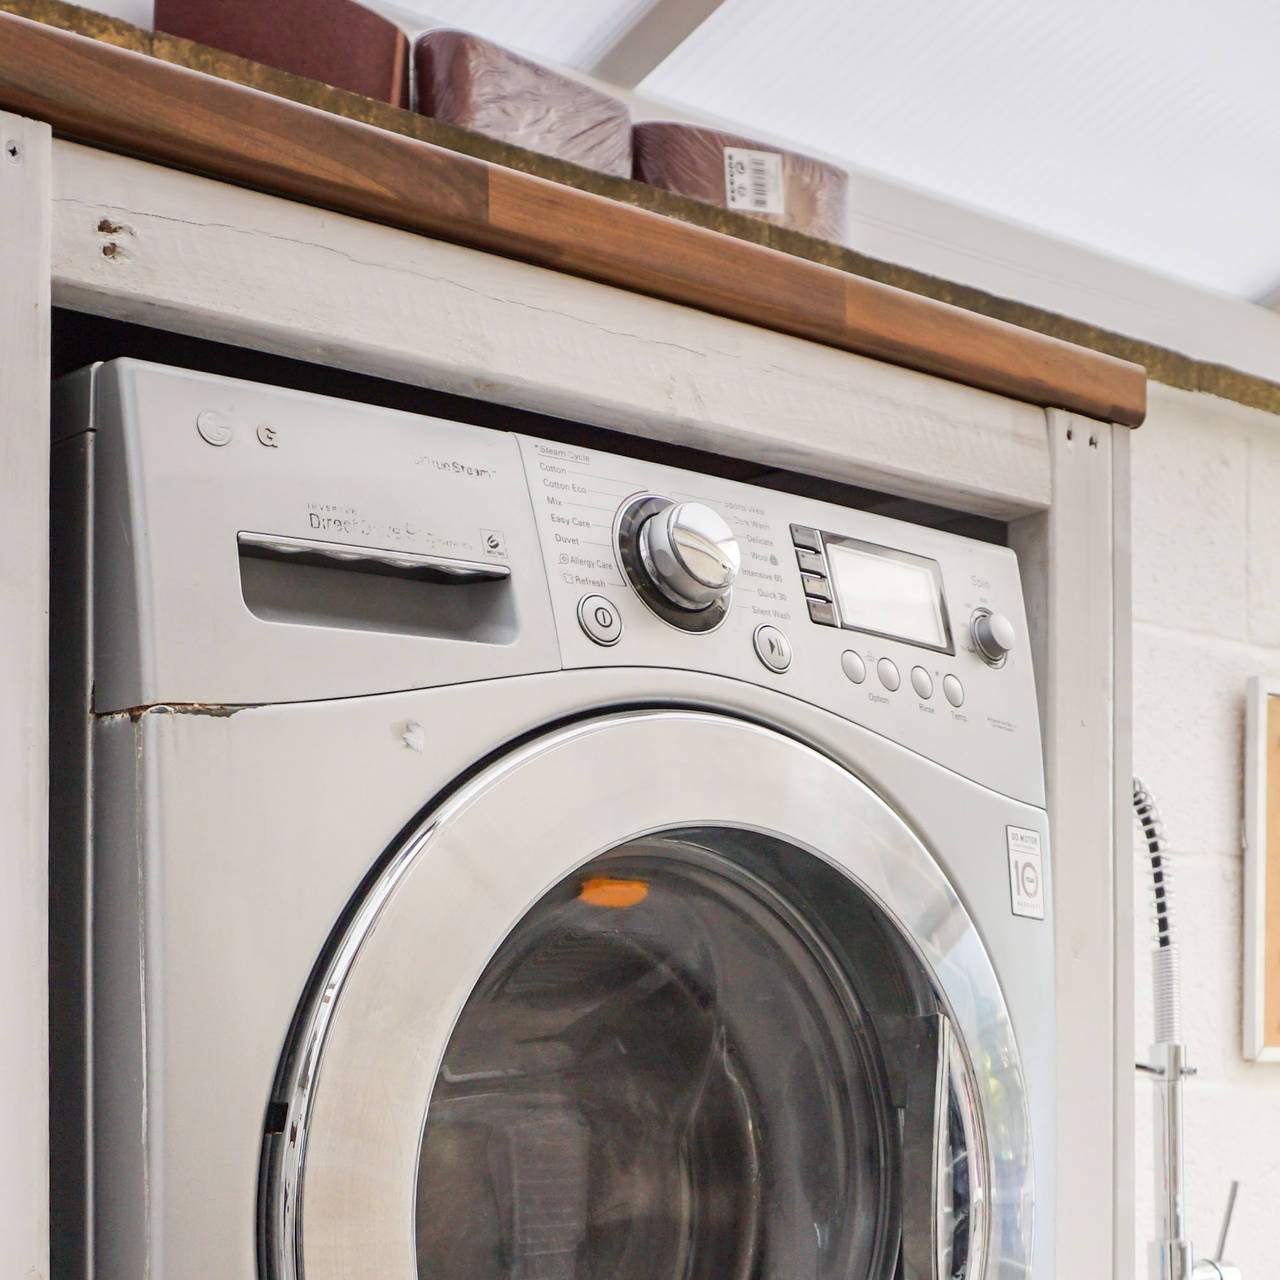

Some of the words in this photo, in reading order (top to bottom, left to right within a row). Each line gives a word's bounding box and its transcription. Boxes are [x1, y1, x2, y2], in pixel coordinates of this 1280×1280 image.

[540, 446, 567, 457] Steam
[540, 462, 567, 475] Cotton
[543, 478, 570, 491] Cotton
[572, 483, 587, 494] Eco
[546, 495, 562, 506] Mix
[550, 513, 570, 526] Easy
[572, 517, 591, 528] Care
[554, 533, 579, 545] Duvet
[746, 534, 775, 547] Delicate
[570, 555, 595, 569] Allergy
[596, 559, 613, 570] Care
[575, 575, 606, 587] Refresh
[751, 605, 772, 617] Silent
[772, 609, 791, 620] Wash
[868, 692, 889, 705] Option
[1014, 860, 1039, 898] 10
